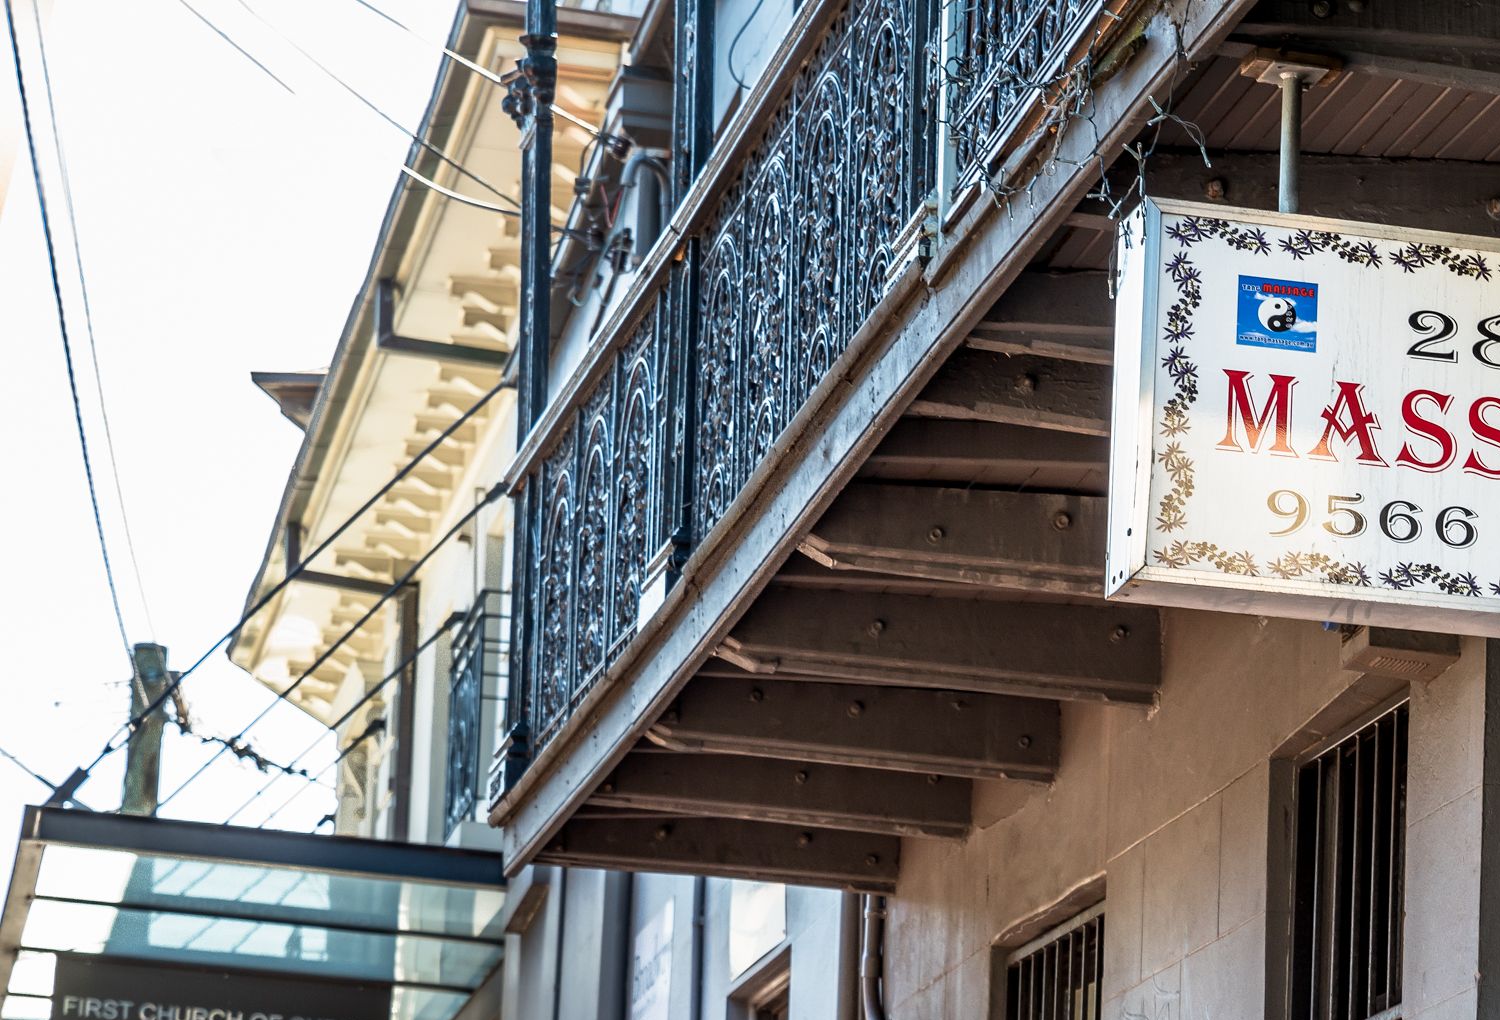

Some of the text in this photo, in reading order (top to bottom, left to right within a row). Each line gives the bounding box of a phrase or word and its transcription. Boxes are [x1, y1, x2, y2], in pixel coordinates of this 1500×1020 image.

[1262, 283, 1315, 297] MASSAGE
[1267, 489, 1478, 551] 9566
[63, 995, 133, 1020] FIRST
